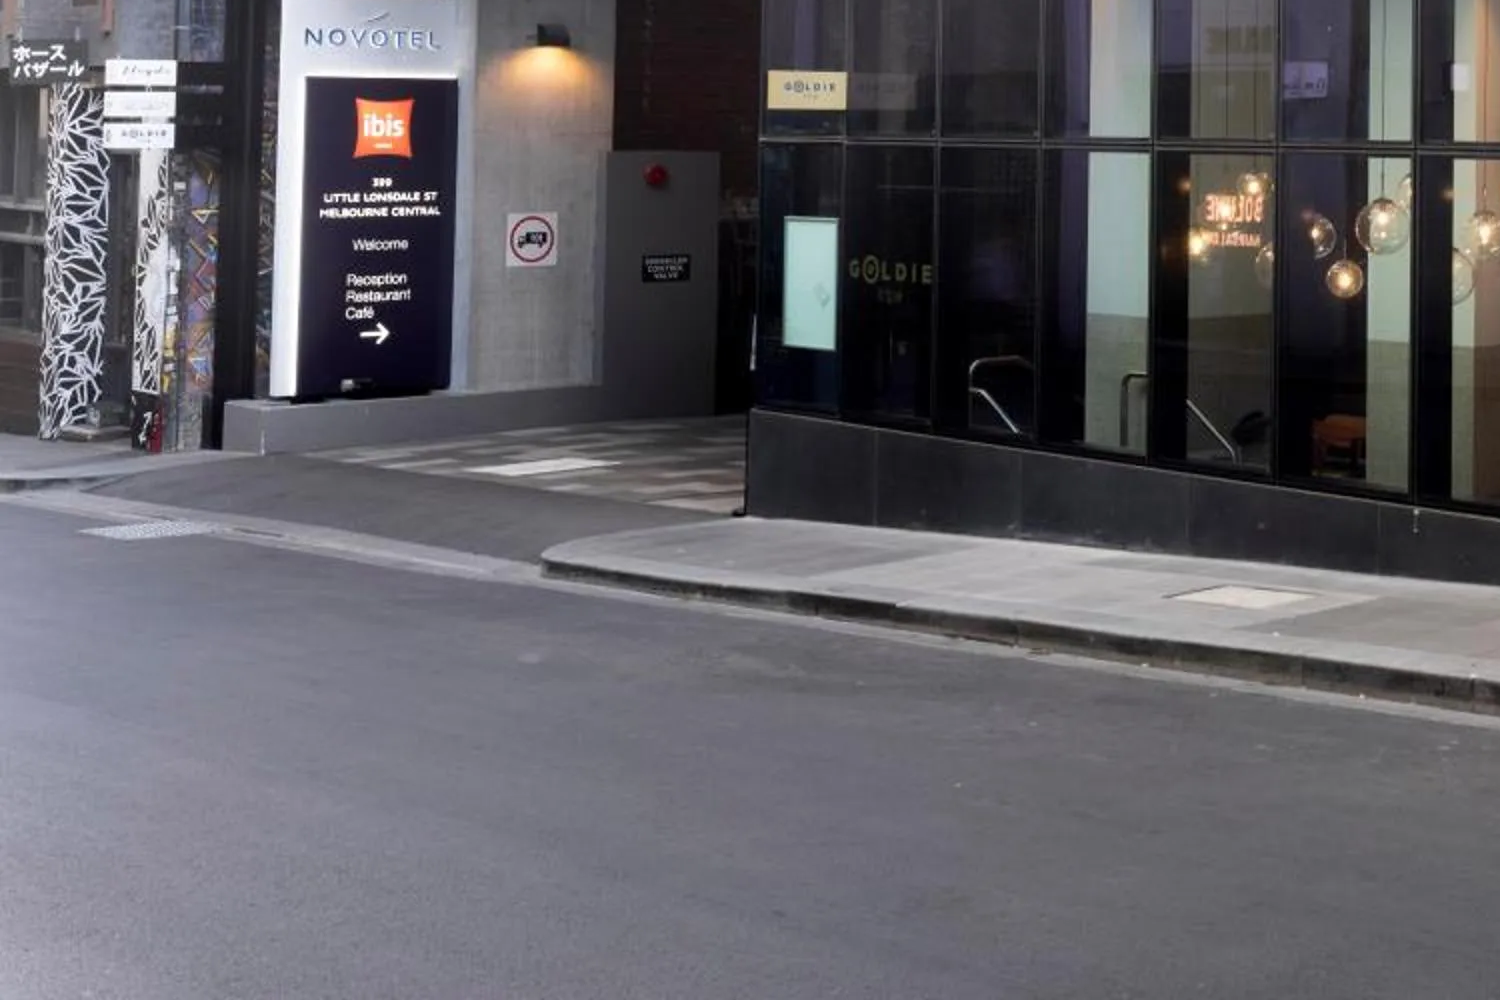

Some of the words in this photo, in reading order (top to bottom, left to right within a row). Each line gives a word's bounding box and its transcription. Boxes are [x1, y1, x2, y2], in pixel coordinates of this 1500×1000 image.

[305, 28, 441, 49] NOVOTEL
[13, 44, 66, 61] ホース
[363, 113, 404, 137] ibis
[323, 192, 361, 203] LITTLE
[363, 192, 421, 202] LONSDALE
[424, 191, 438, 201] ST
[319, 207, 388, 219] MELBOURNE
[392, 206, 441, 217] CENTRAL
[353, 238, 409, 251] Welcome
[848, 254, 934, 285] GOLDIE
[347, 272, 407, 287] Reception
[346, 288, 411, 302] Restaurant
[345, 306, 375, 319] Café
